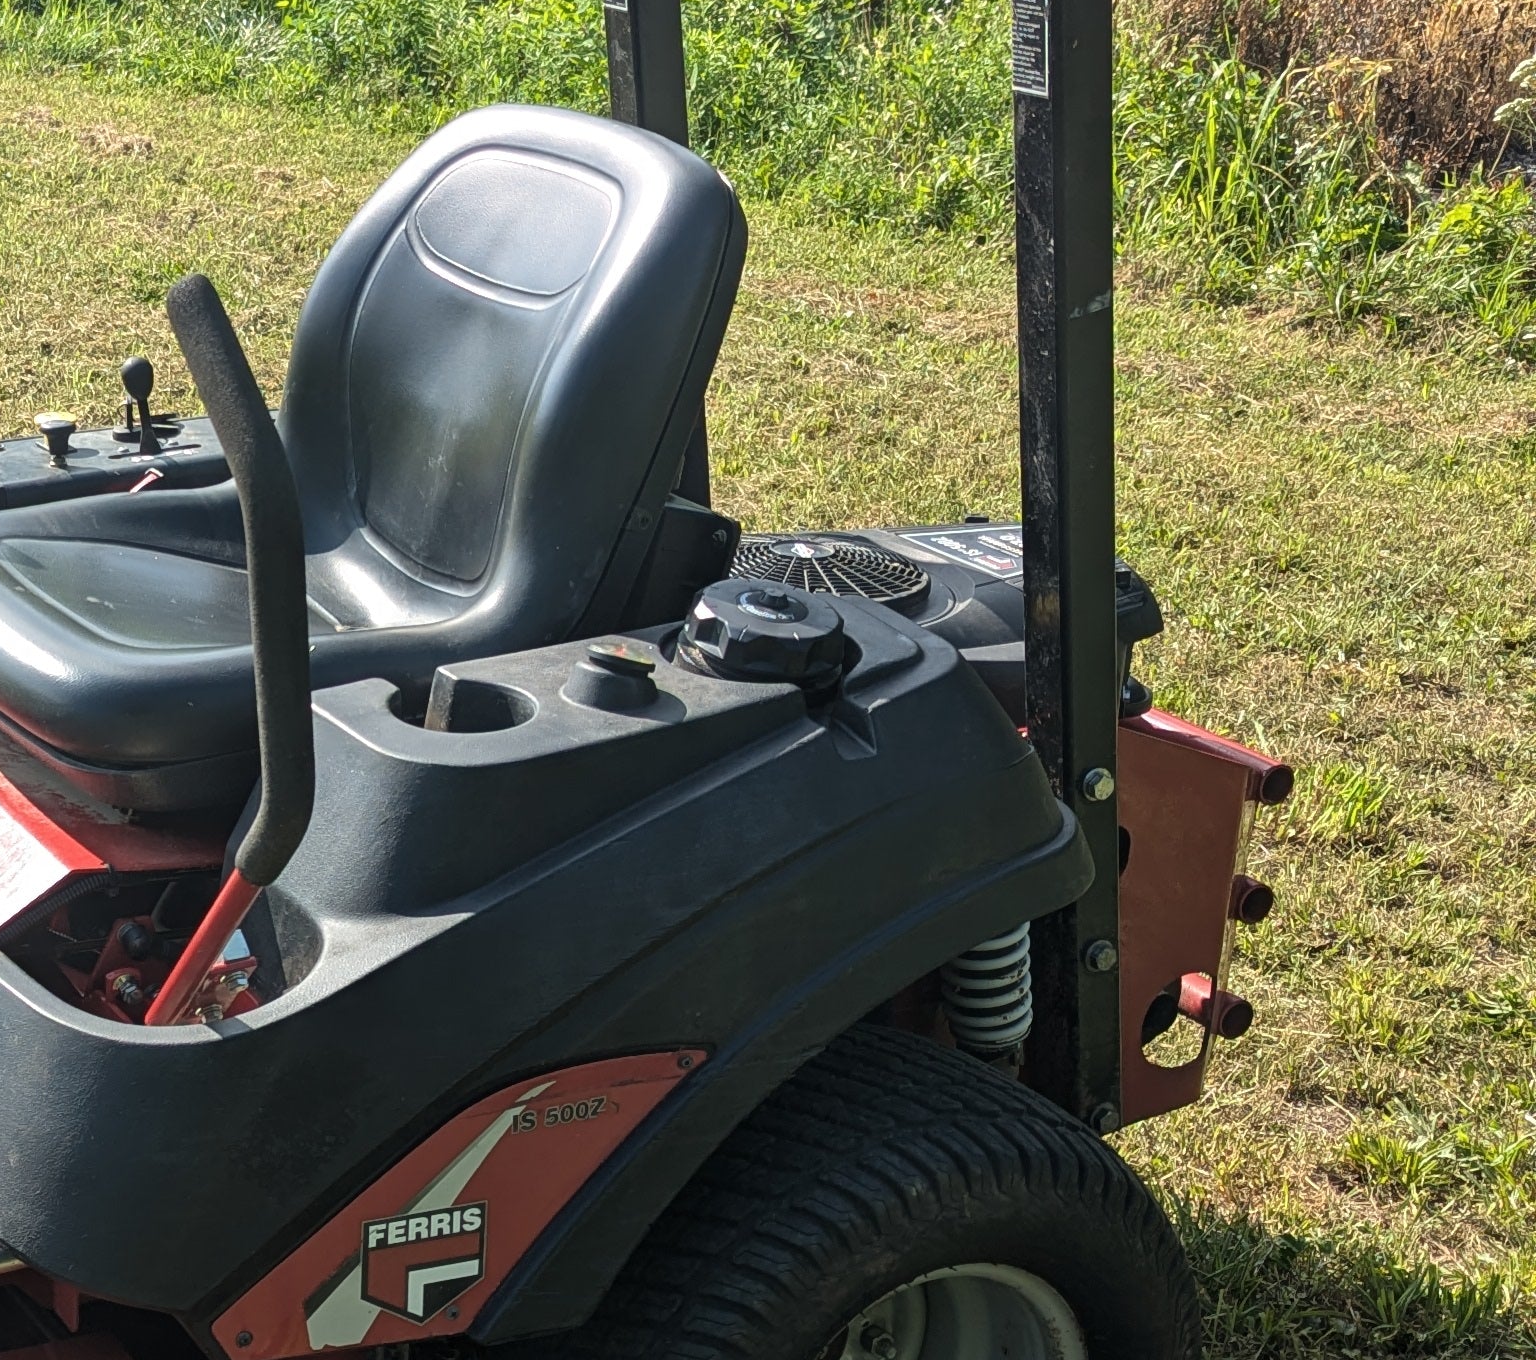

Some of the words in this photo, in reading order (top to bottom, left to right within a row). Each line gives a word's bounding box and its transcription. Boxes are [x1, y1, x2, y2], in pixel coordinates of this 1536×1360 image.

[511, 1111, 537, 1134] IS
[544, 1096, 607, 1127] 500Z
[367, 1207, 482, 1249] FERRIS
